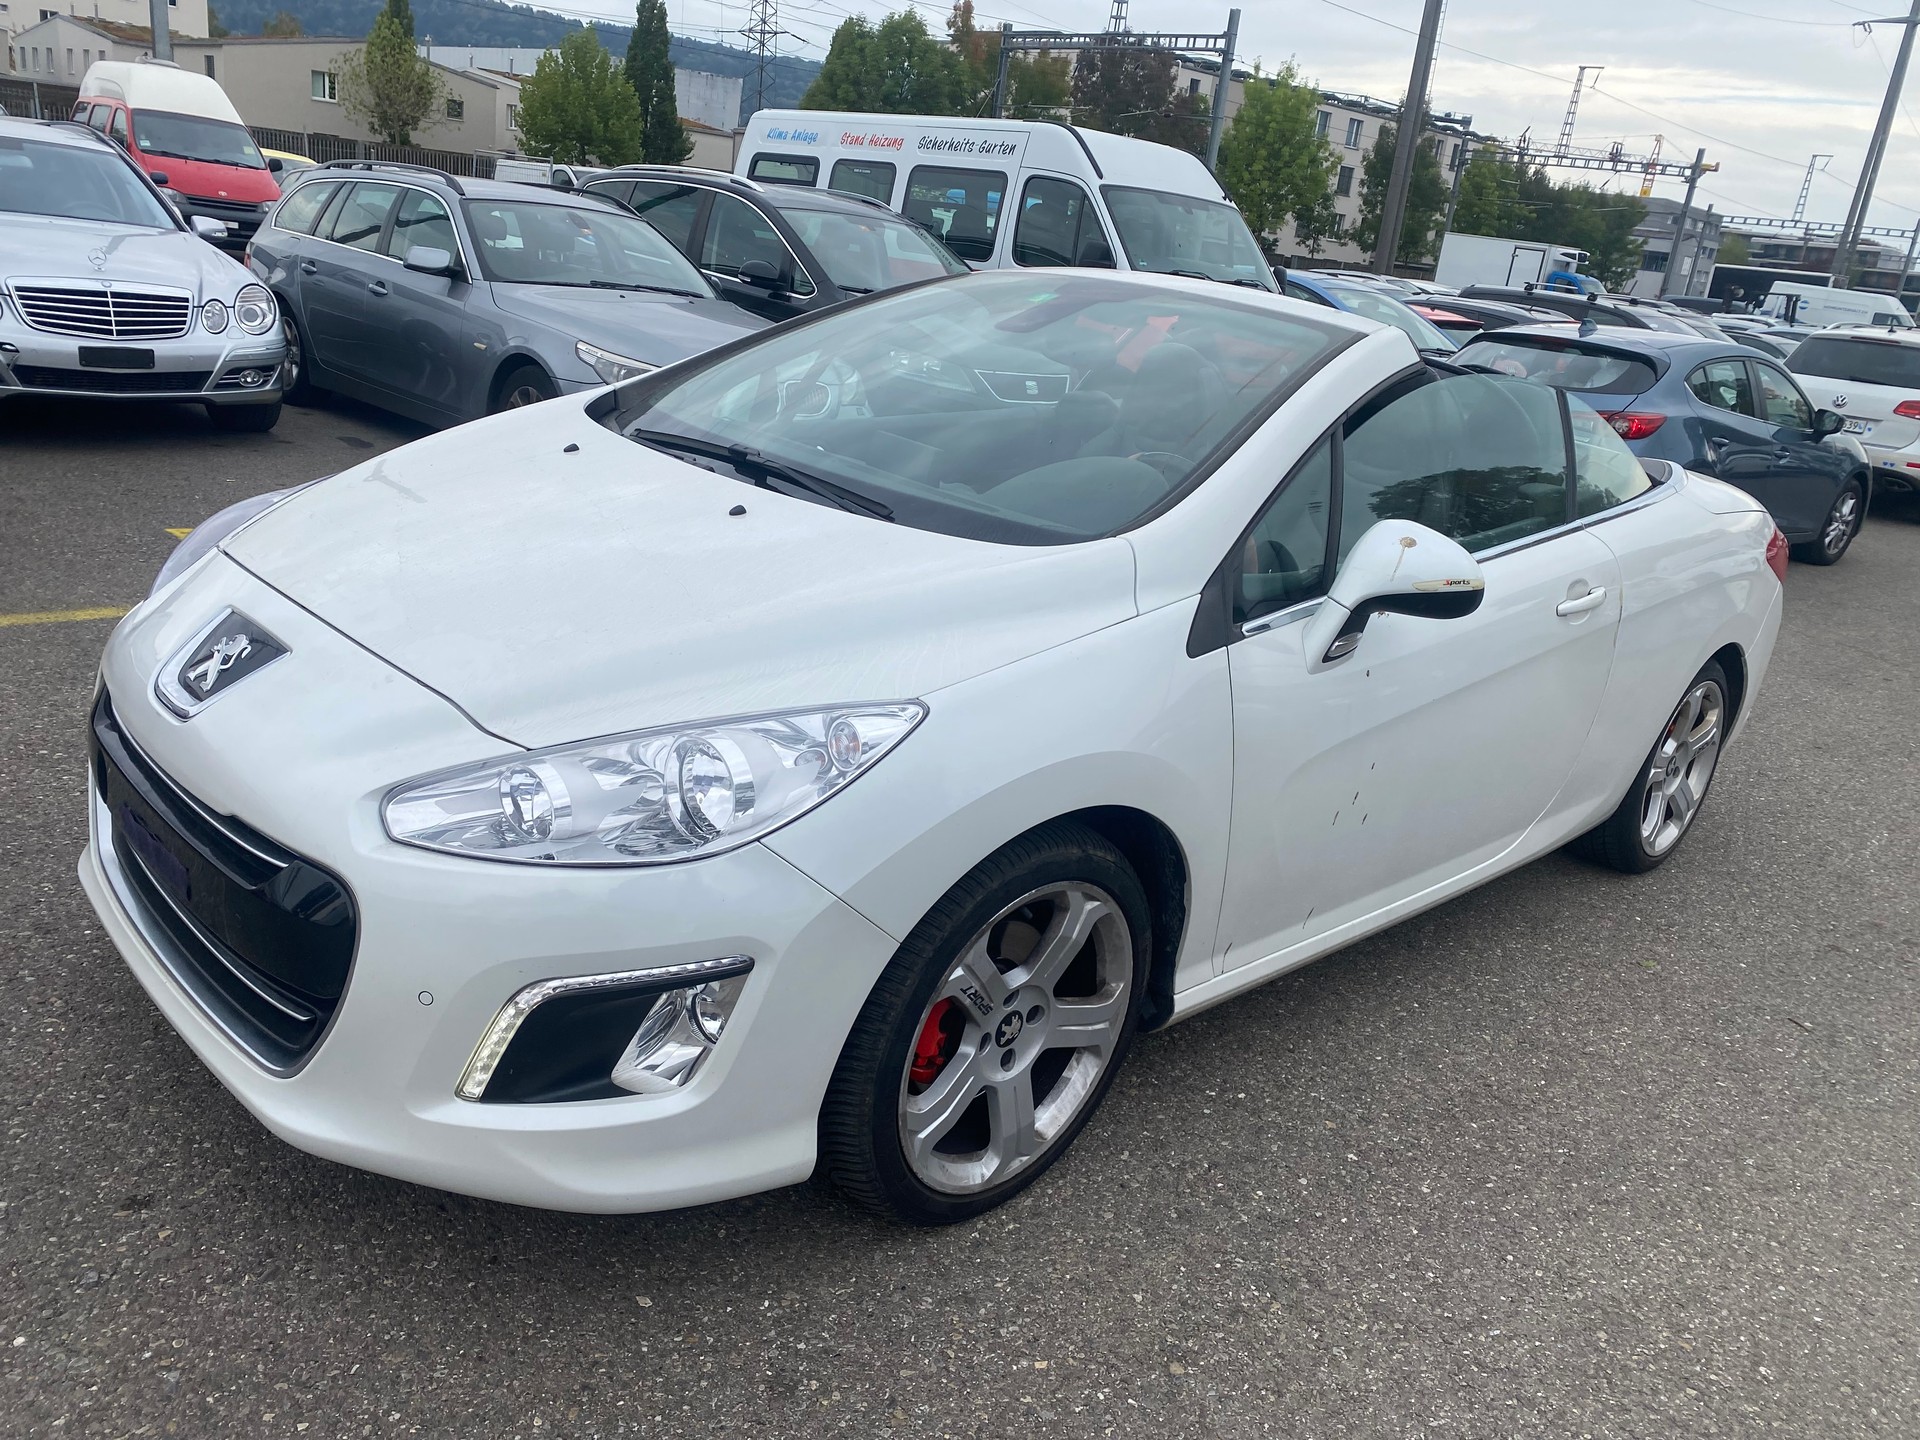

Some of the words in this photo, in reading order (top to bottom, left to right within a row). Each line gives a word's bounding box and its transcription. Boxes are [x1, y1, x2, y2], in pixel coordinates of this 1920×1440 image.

[840, 132, 904, 151] Stand-Heizung
[918, 136, 1017, 155] Sicherheits-Gurten
[960, 986, 993, 1016] SPORT
